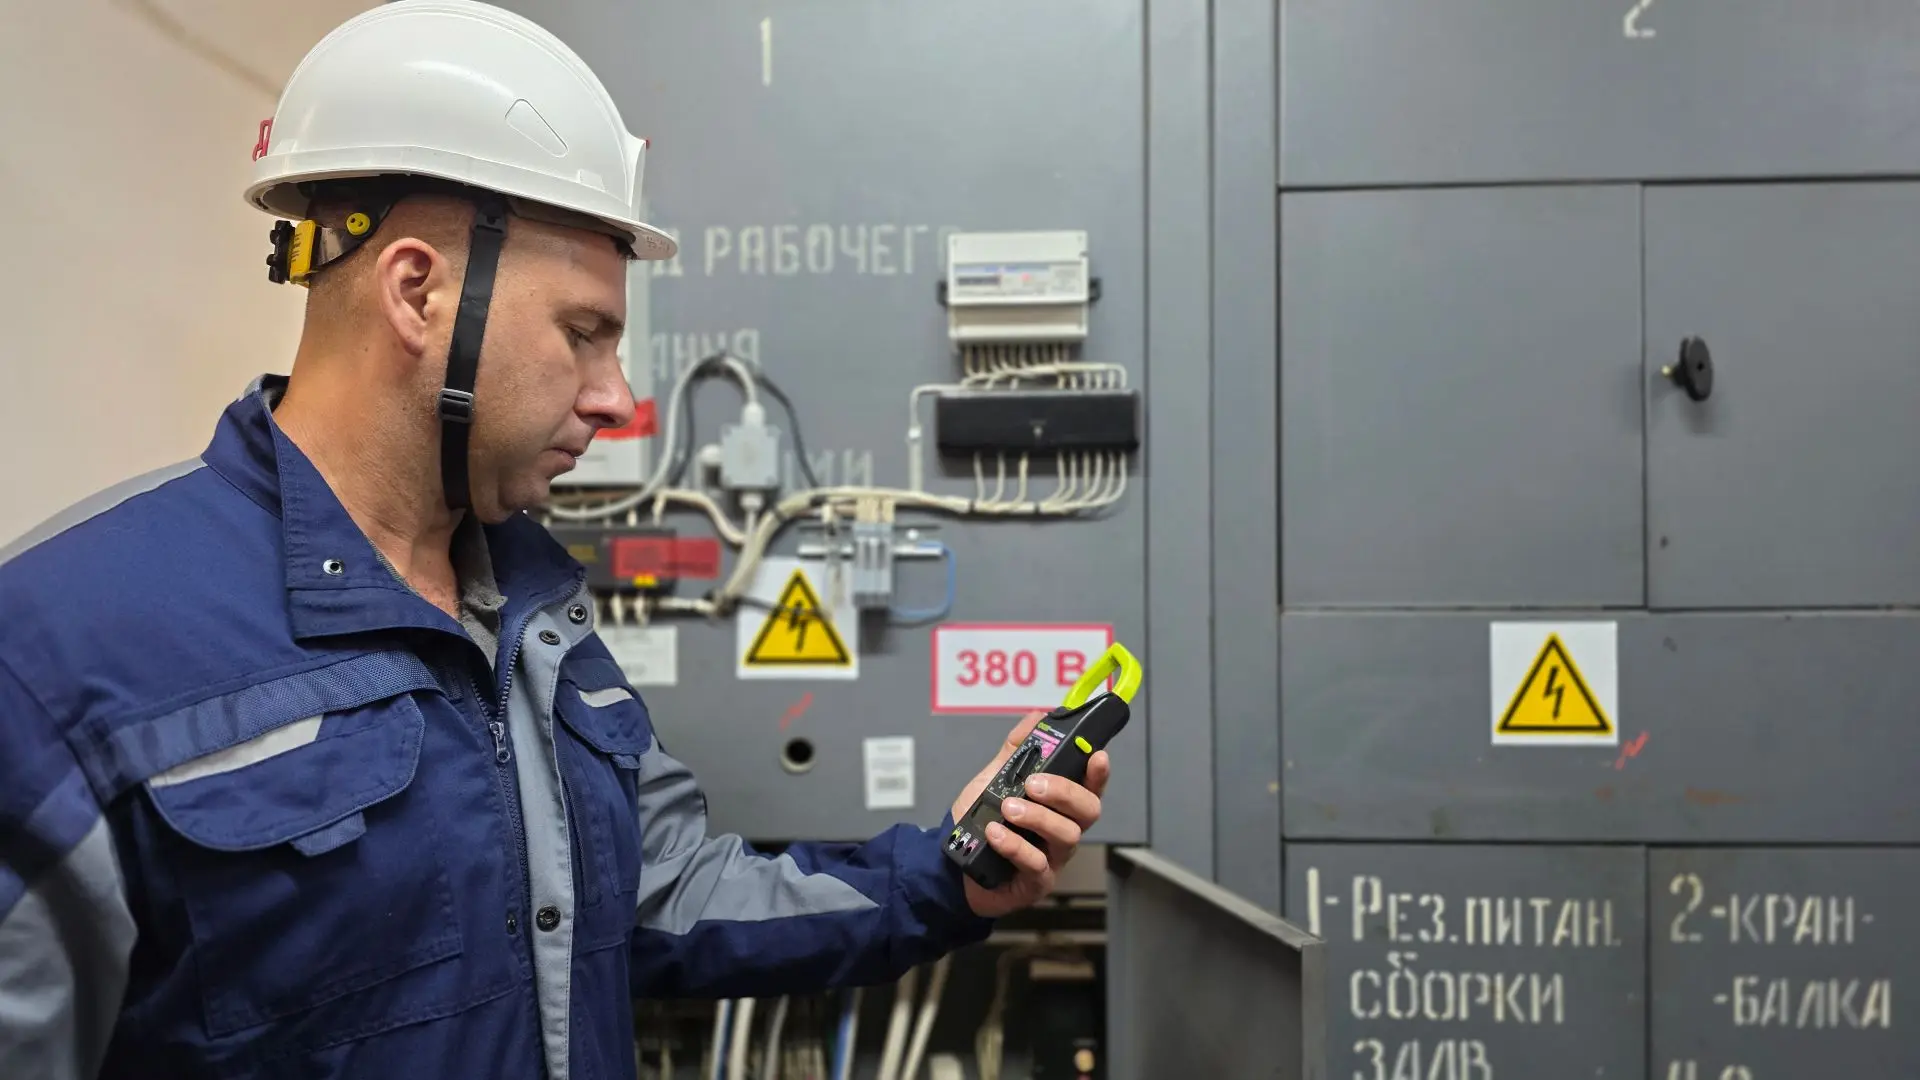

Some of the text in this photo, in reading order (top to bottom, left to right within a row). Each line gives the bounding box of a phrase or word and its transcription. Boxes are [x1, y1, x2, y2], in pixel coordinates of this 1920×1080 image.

[759, 16, 772, 87] 1
[956, 650, 1088, 687] 380 В
